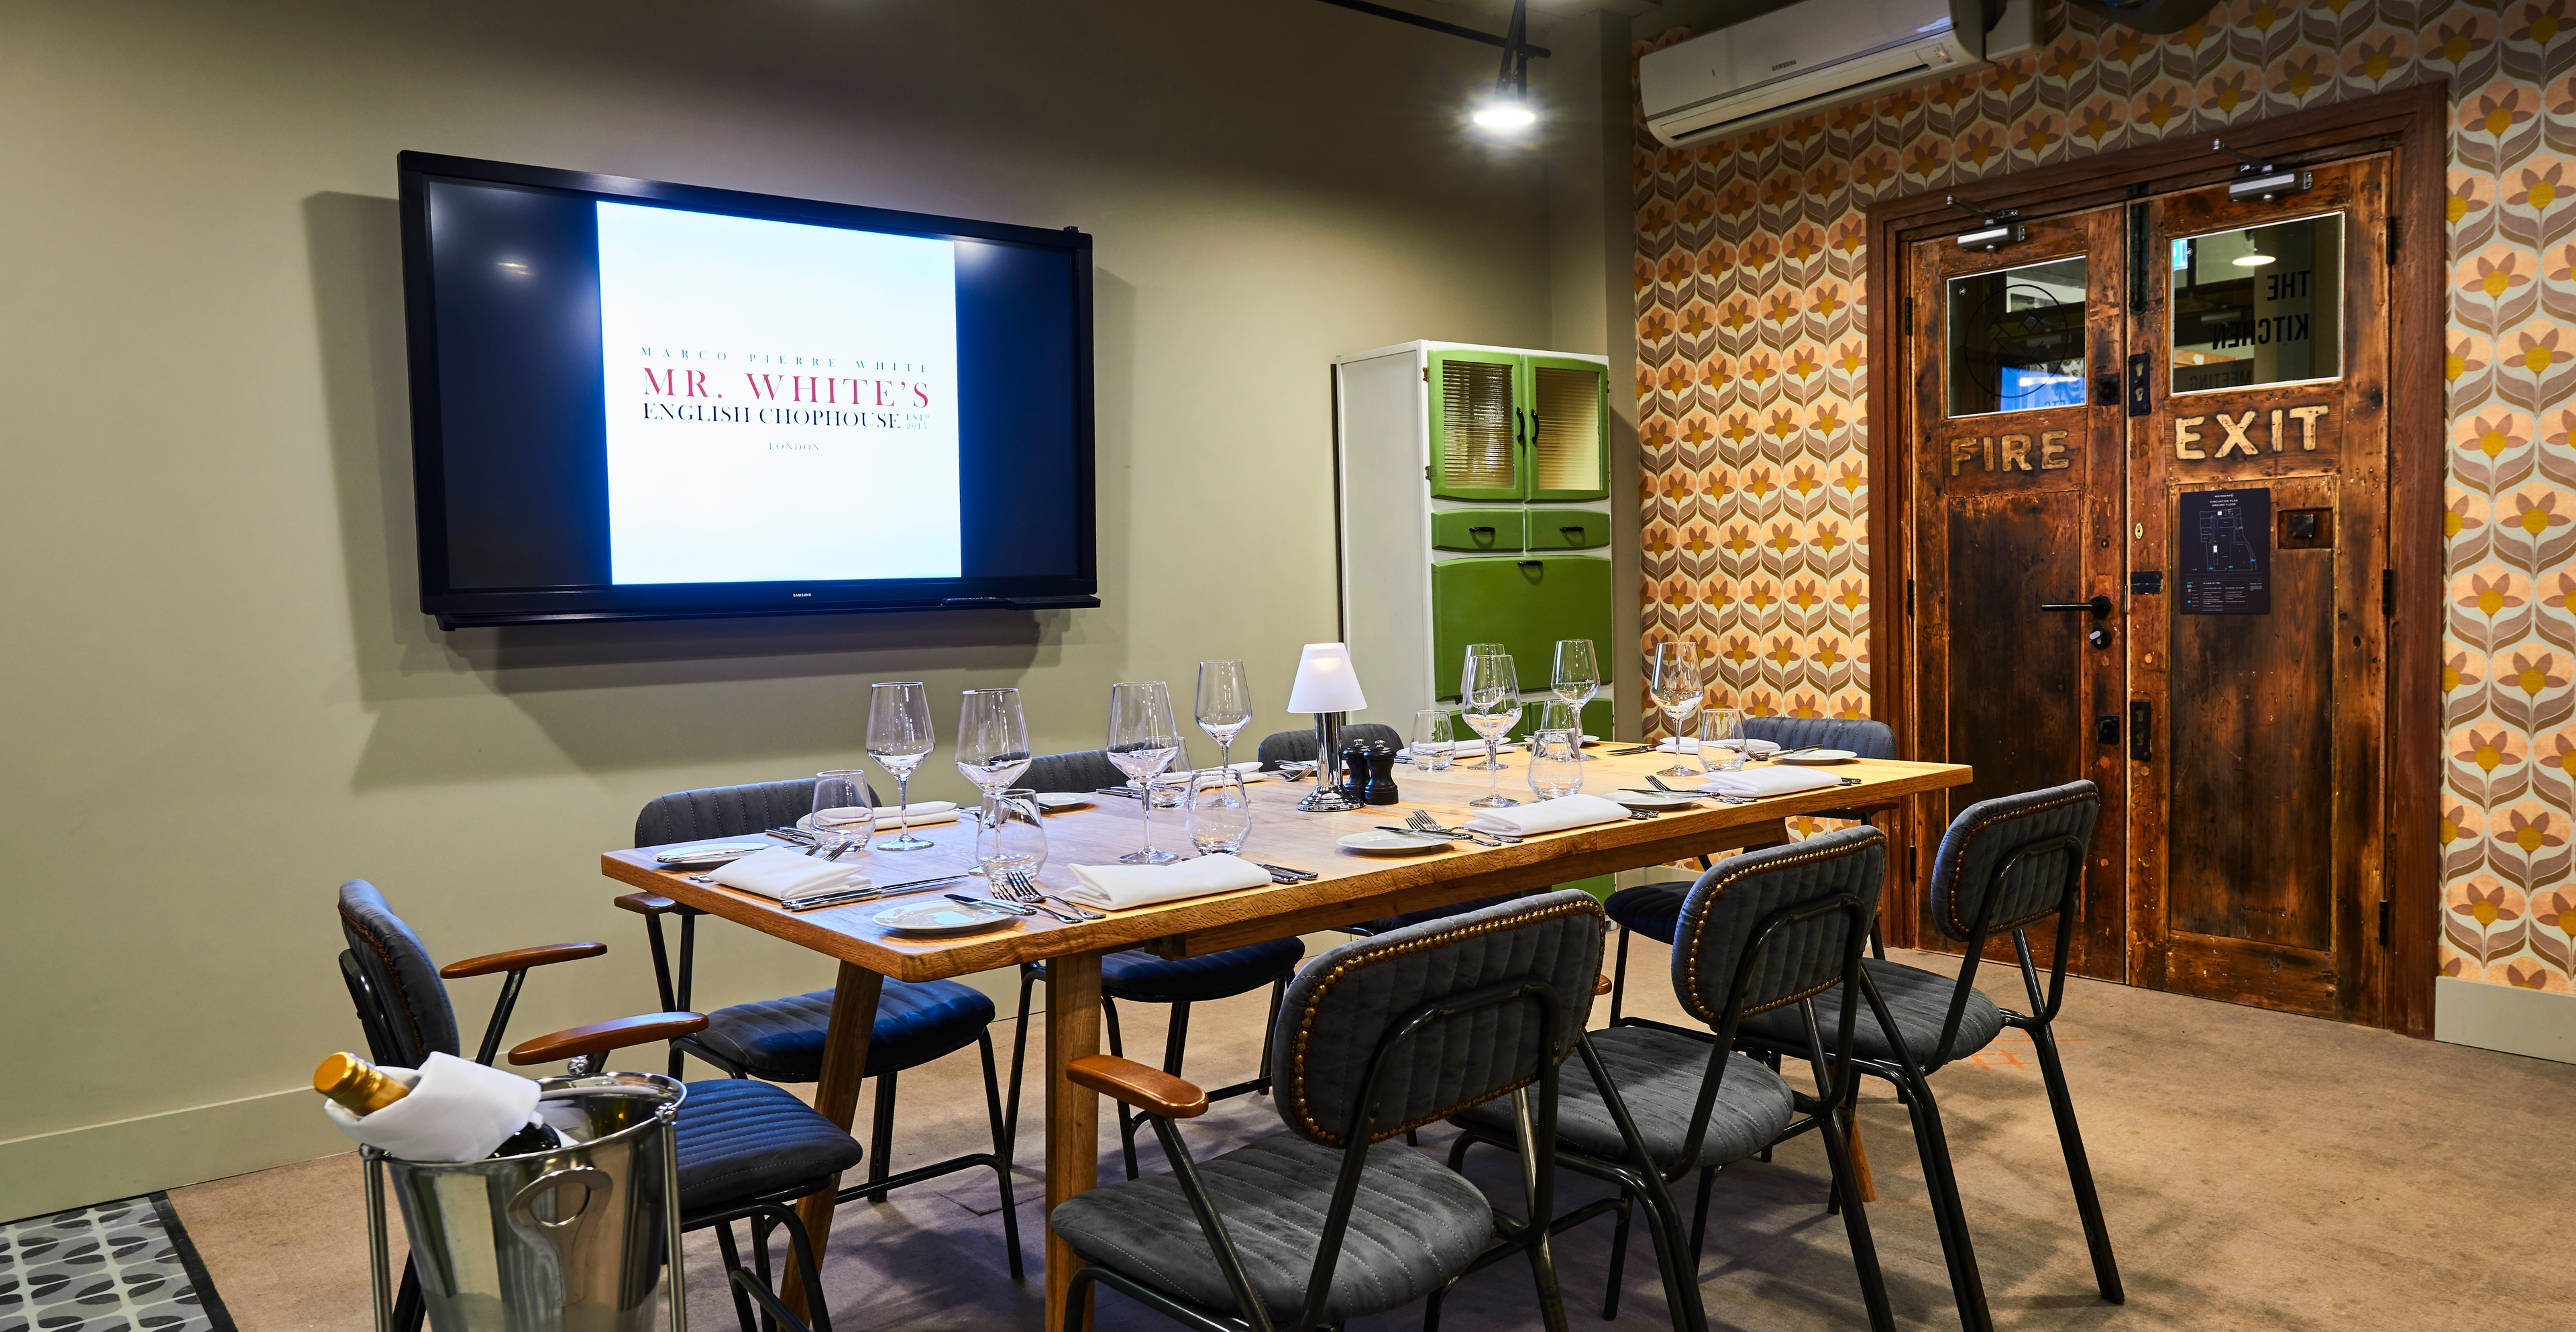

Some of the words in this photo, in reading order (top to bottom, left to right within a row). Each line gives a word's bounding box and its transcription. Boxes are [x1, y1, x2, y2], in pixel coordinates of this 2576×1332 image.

[1772, 59, 1796, 71] SAMSUNG
[641, 347, 727, 360] MARCO
[749, 354, 836, 368] PIERRE
[855, 360, 928, 373] WHITE
[642, 367, 722, 399] MR.
[745, 372, 929, 409] WHITE'S
[643, 403, 750, 423] ENGLISH
[759, 407, 901, 429] CHOPHOUSE
[769, 442, 820, 451] LONDON
[1950, 430, 2069, 476] FIRE
[2175, 405, 2329, 460] EXIT
